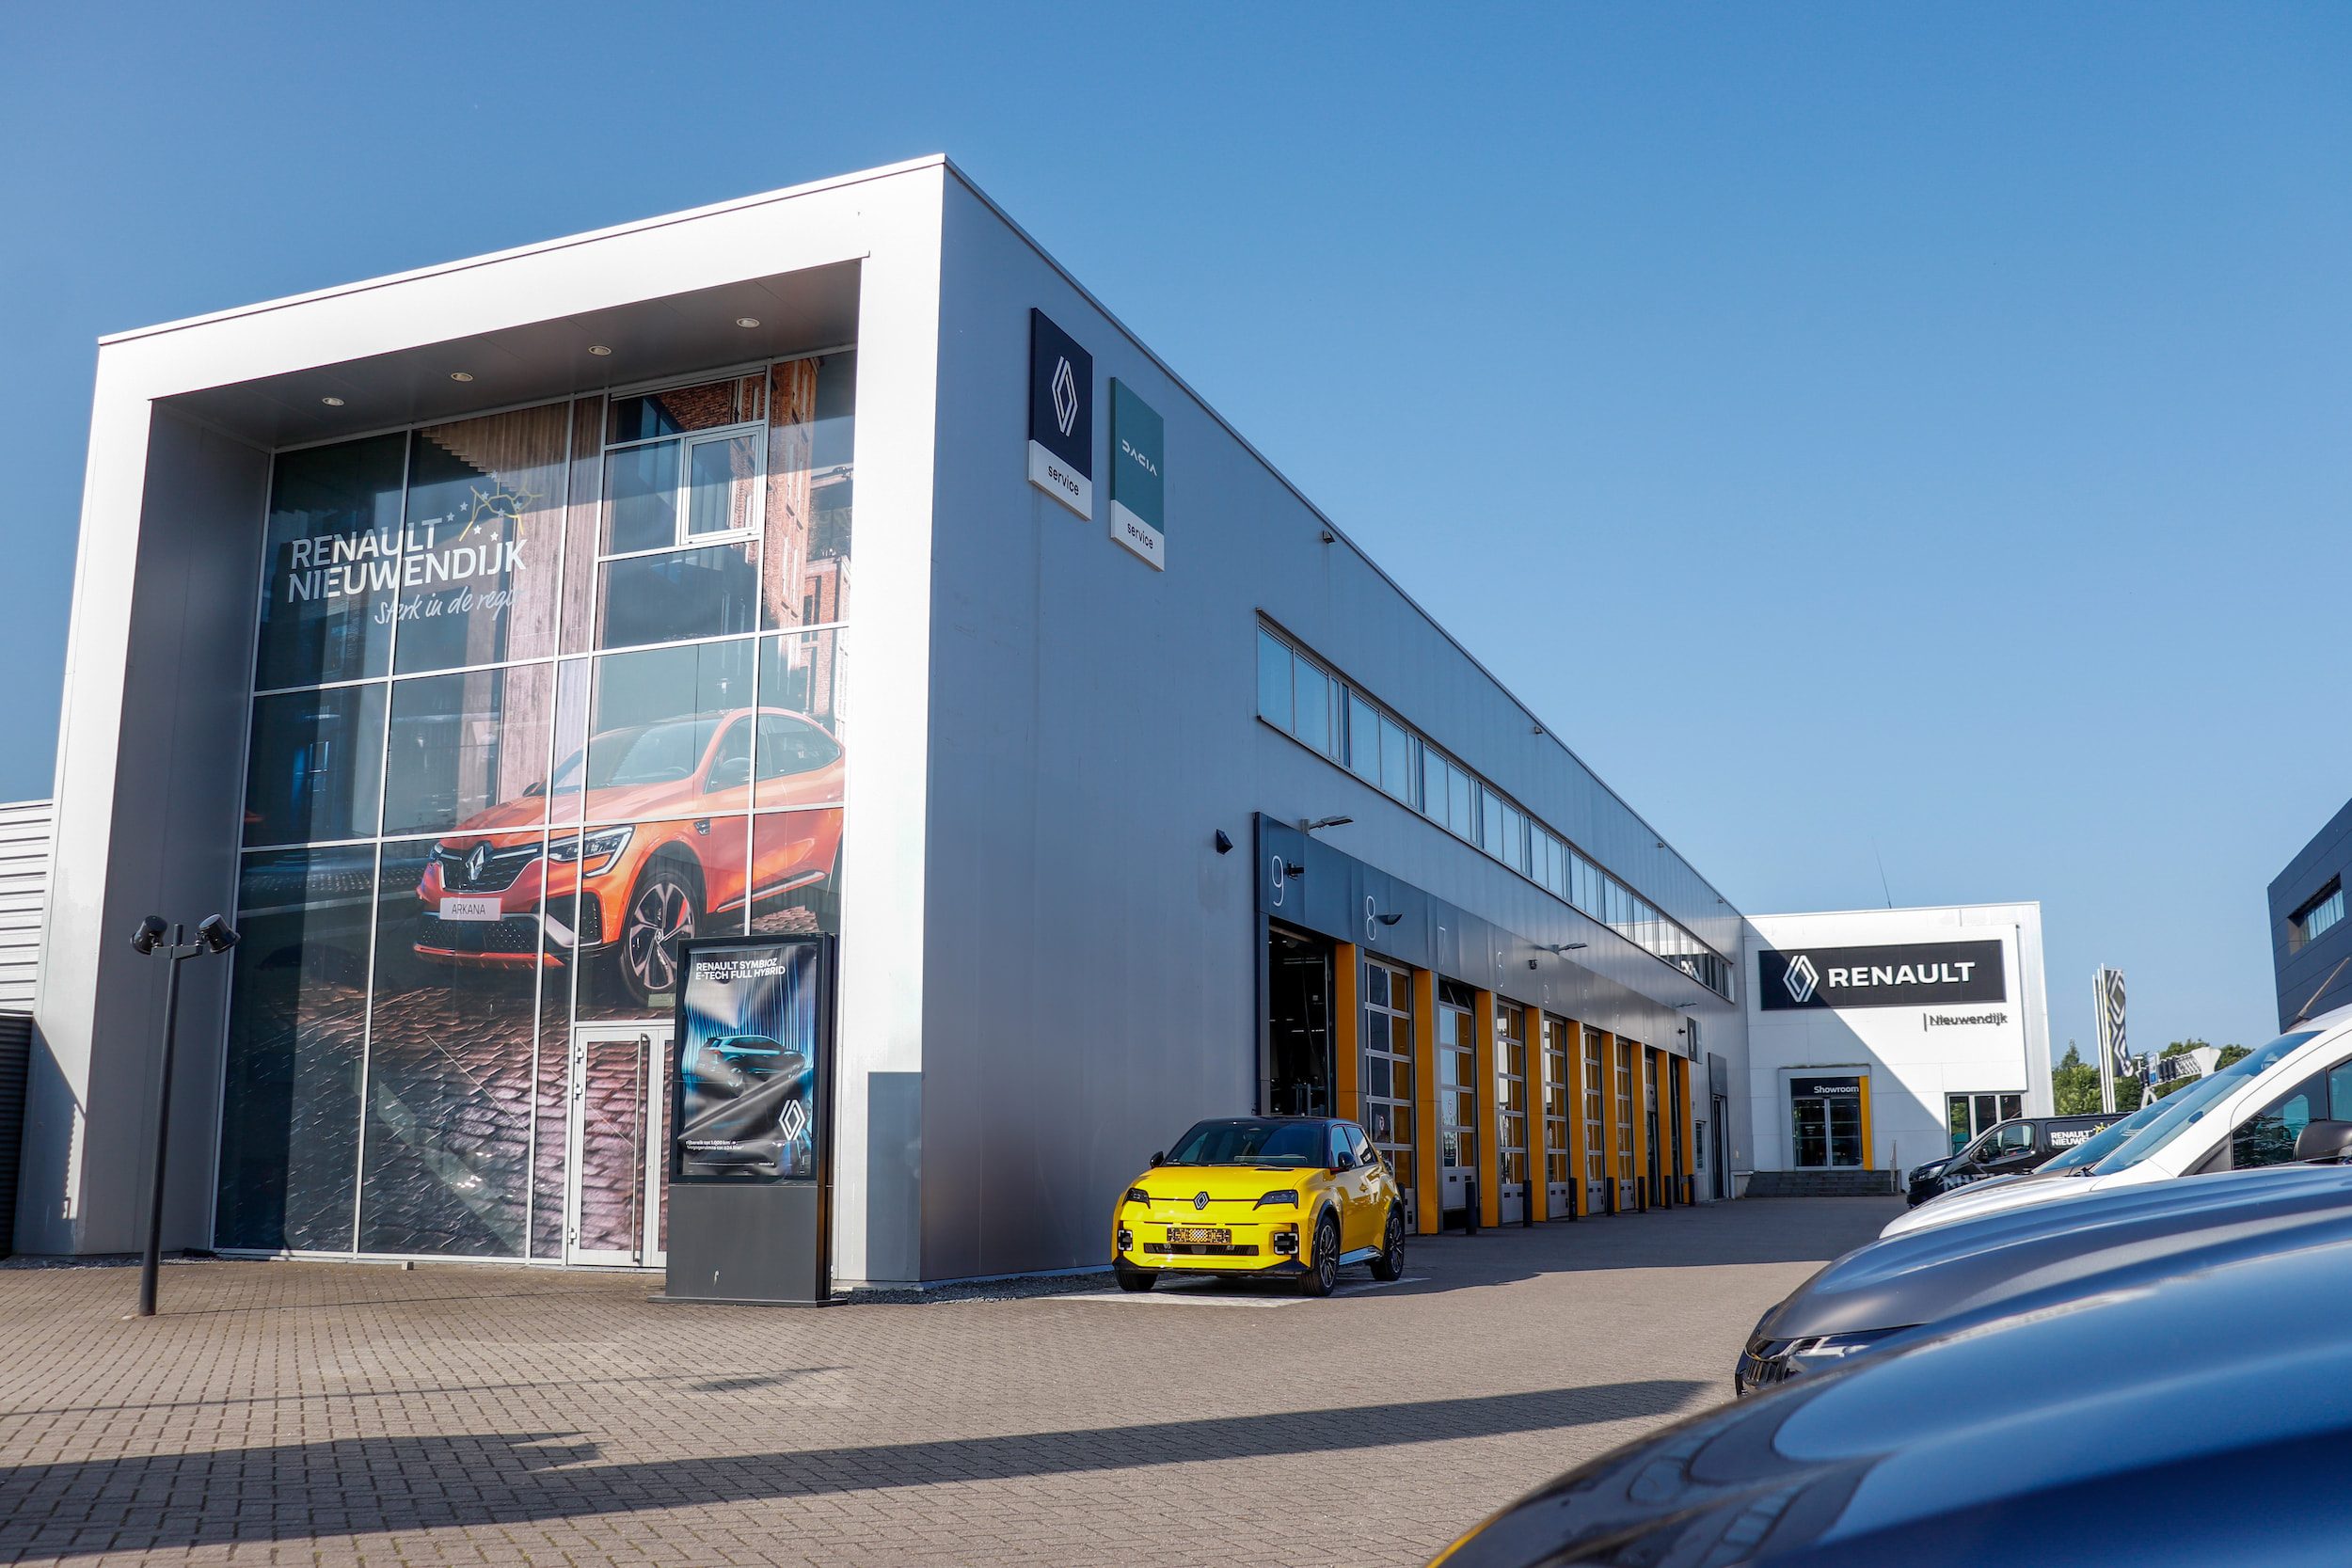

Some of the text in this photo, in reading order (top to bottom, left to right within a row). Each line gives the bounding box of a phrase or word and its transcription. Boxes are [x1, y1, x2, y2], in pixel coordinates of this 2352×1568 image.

[1121, 438, 1158, 477] DACIA
[1047, 465, 1080, 497] service
[291, 517, 443, 570] RENAULT
[1127, 522, 1154, 549] service
[288, 539, 528, 603] NIEUWENDIJK
[425, 593, 444, 618] in
[447, 585, 475, 614] de
[1271, 855, 1284, 907] 9
[452, 903, 486, 915] ARKANA
[1366, 895, 1377, 942] 8
[695, 965, 787, 980] E-TECH FULL HYBRID
[696, 958, 778, 972] RENAULT SYMBIOZ
[1827, 961, 1976, 989] RENAULT
[1929, 1012, 2009, 1027] Nieuwendijk
[1813, 1085, 1860, 1094] Showroom
[2050, 1131, 2090, 1139] RENAULT
